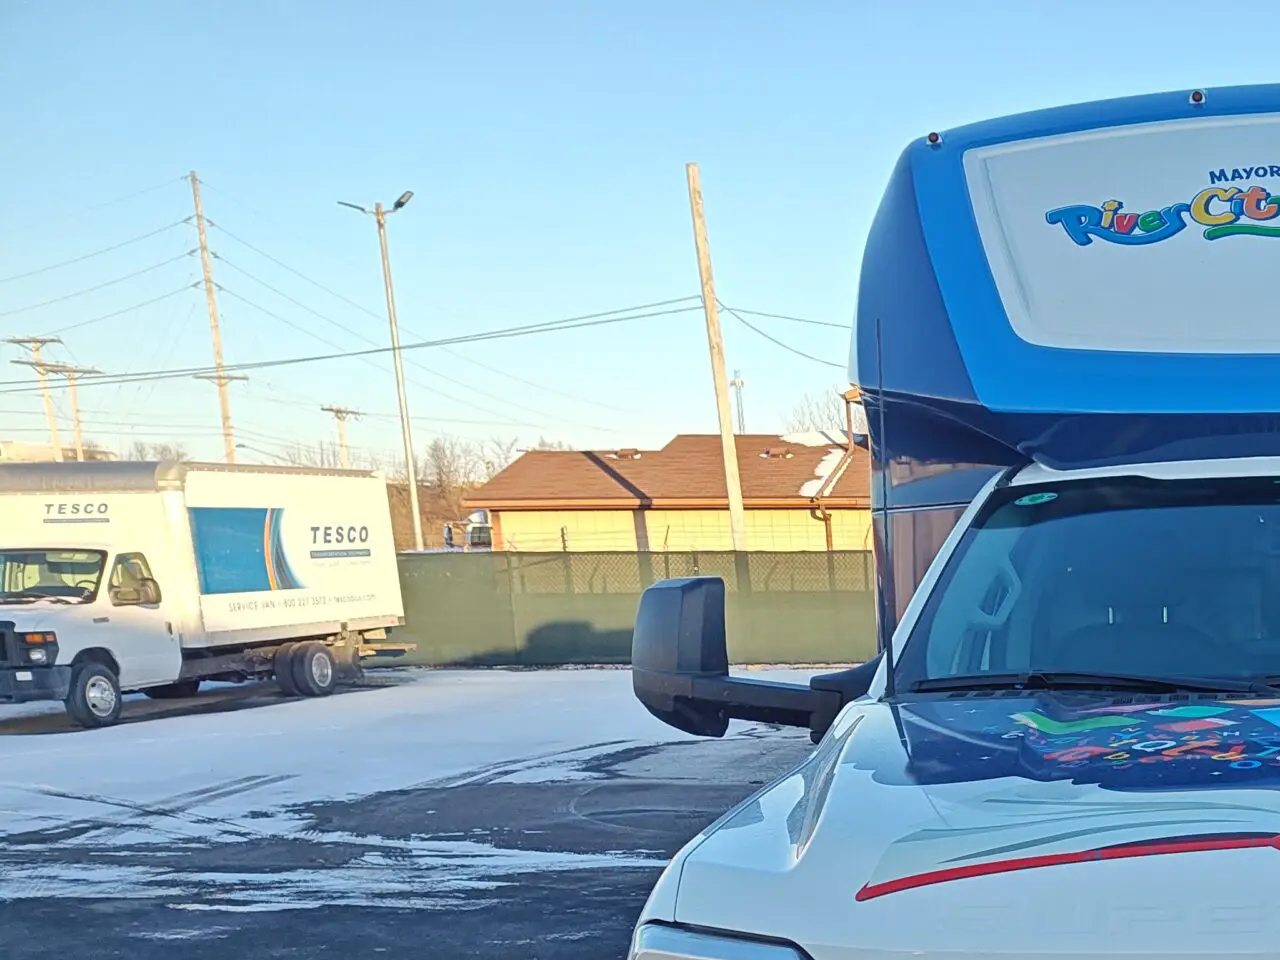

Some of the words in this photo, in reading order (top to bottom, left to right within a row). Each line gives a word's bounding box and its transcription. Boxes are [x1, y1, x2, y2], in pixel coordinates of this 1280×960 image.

[1045, 199, 1189, 246] River
[44, 503, 109, 515] TESCO
[310, 526, 369, 544] TESCO
